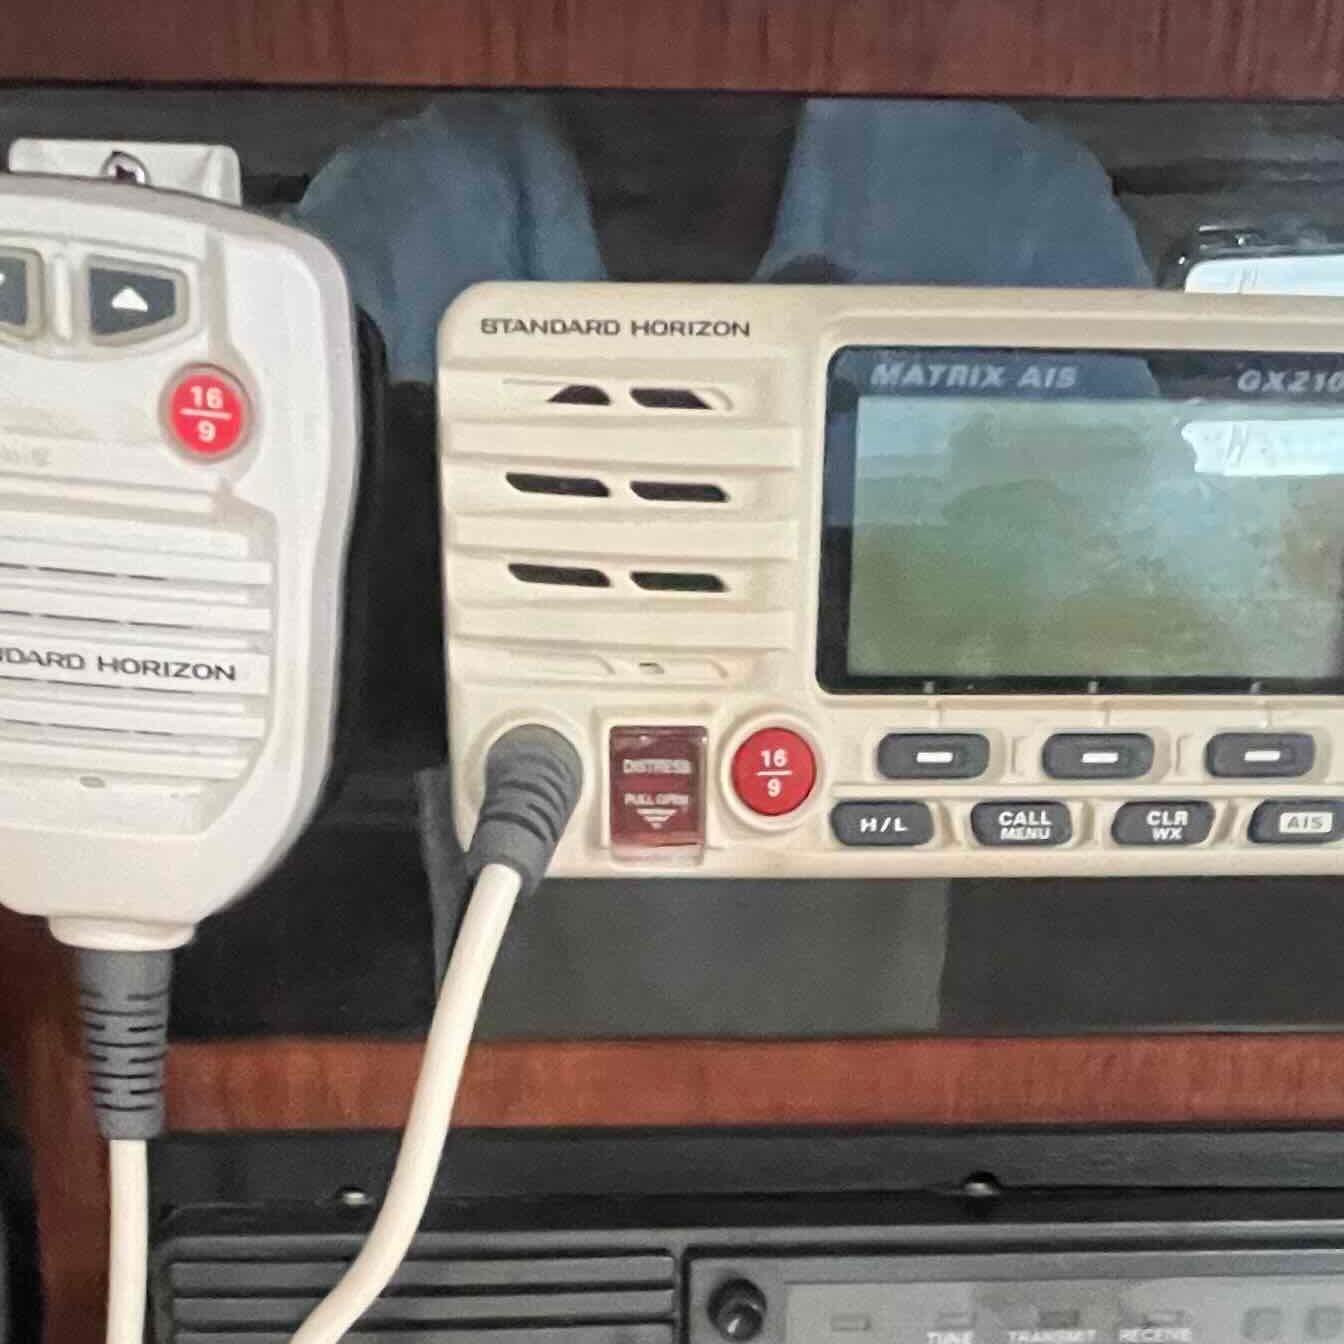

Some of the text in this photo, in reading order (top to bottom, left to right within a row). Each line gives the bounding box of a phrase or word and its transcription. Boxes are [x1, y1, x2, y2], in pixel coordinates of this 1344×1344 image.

[481, 317, 750, 337] STANDARD HORIZON
[870, 363, 1077, 389] MATRIX AIS
[191, 386, 223, 409] 16
[197, 420, 216, 441] 9
[97, 655, 237, 681] HORIZON
[760, 749, 788, 767] 16
[767, 779, 782, 797] 9
[859, 817, 908, 833] H/L
[998, 811, 1052, 826] CALL
[1147, 811, 1189, 827] CLR
[1285, 814, 1326, 831] AIS
[1151, 827, 1182, 841] WX
